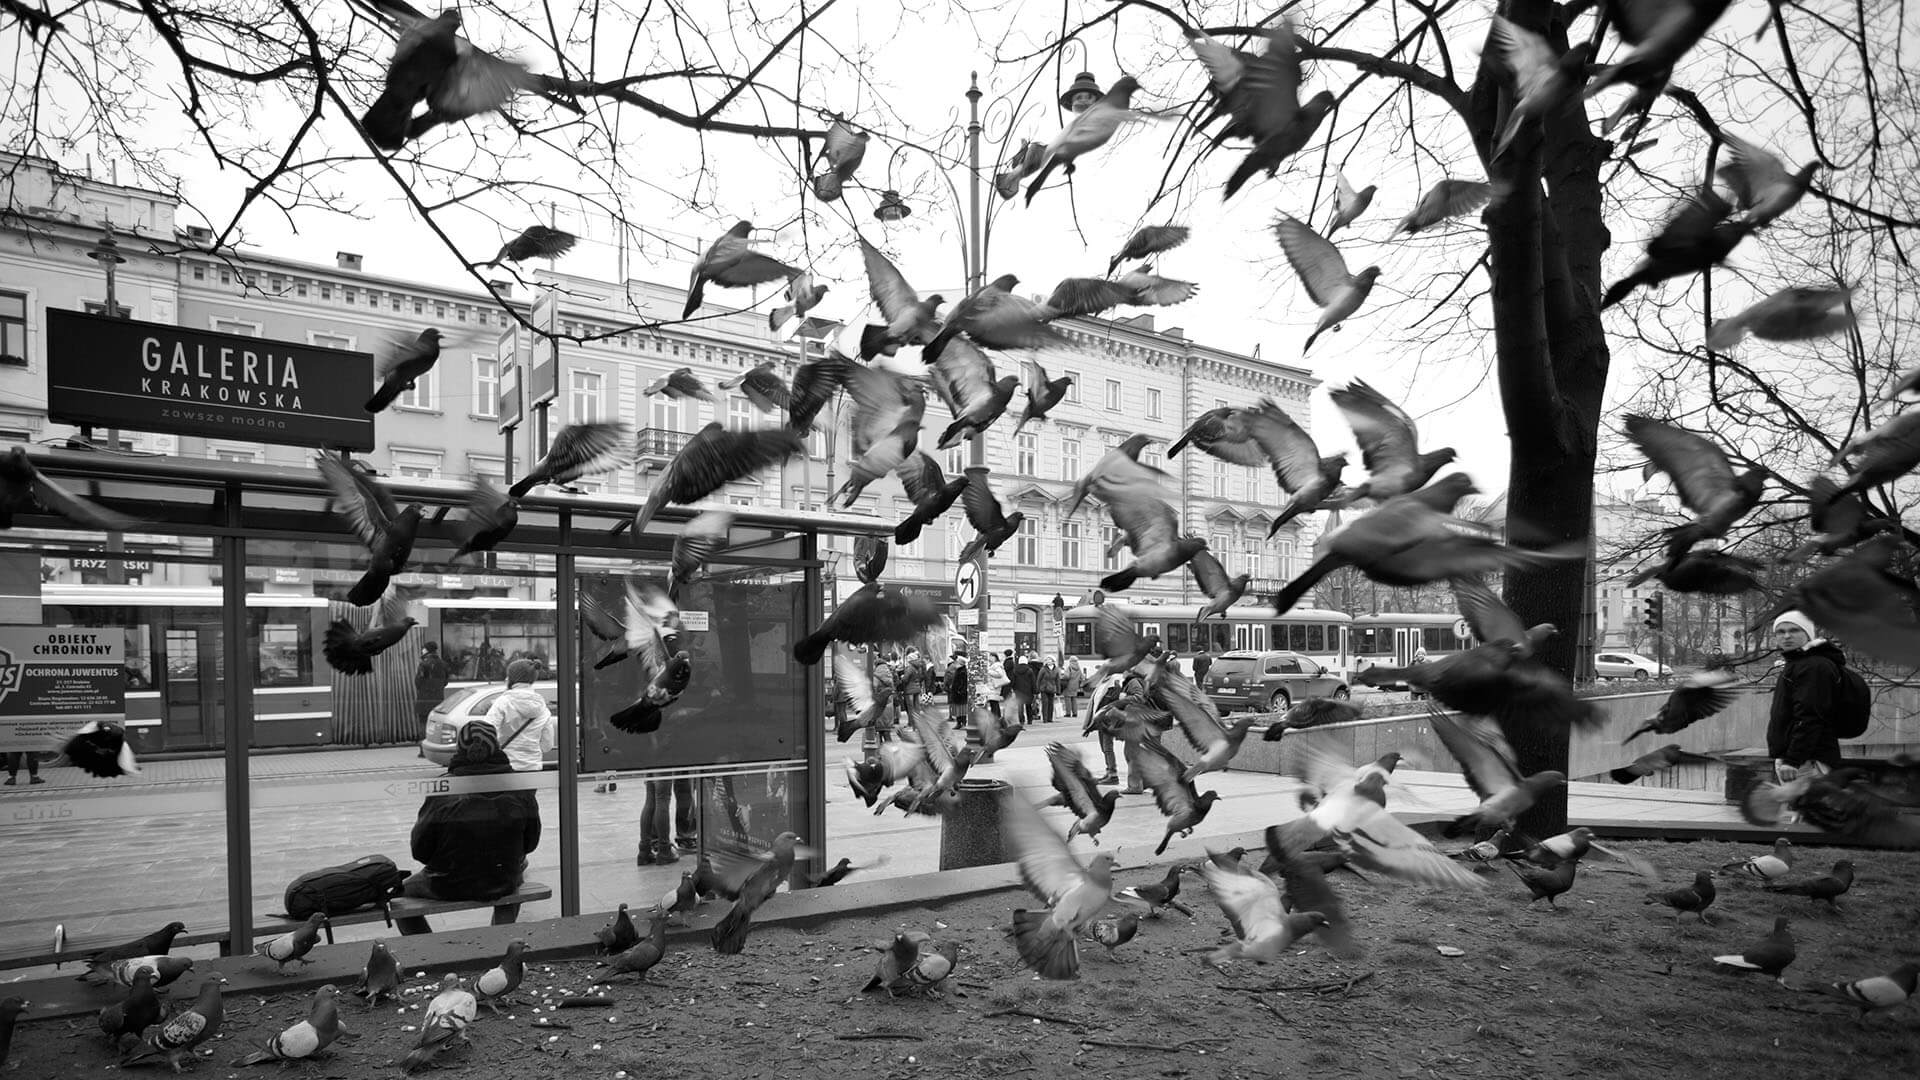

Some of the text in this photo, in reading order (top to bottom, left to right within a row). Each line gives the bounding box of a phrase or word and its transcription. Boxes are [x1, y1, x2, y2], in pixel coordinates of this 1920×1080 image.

[142, 337, 299, 389] GALERIA
[142, 377, 302, 410] KRAKOWSKA
[162, 408, 286, 429] zawsze modna
[48, 634, 97, 644] OBIEKT
[33, 645, 112, 655] CHRONIONY
[25, 668, 119, 677] OCHRONA JUWENTUS
